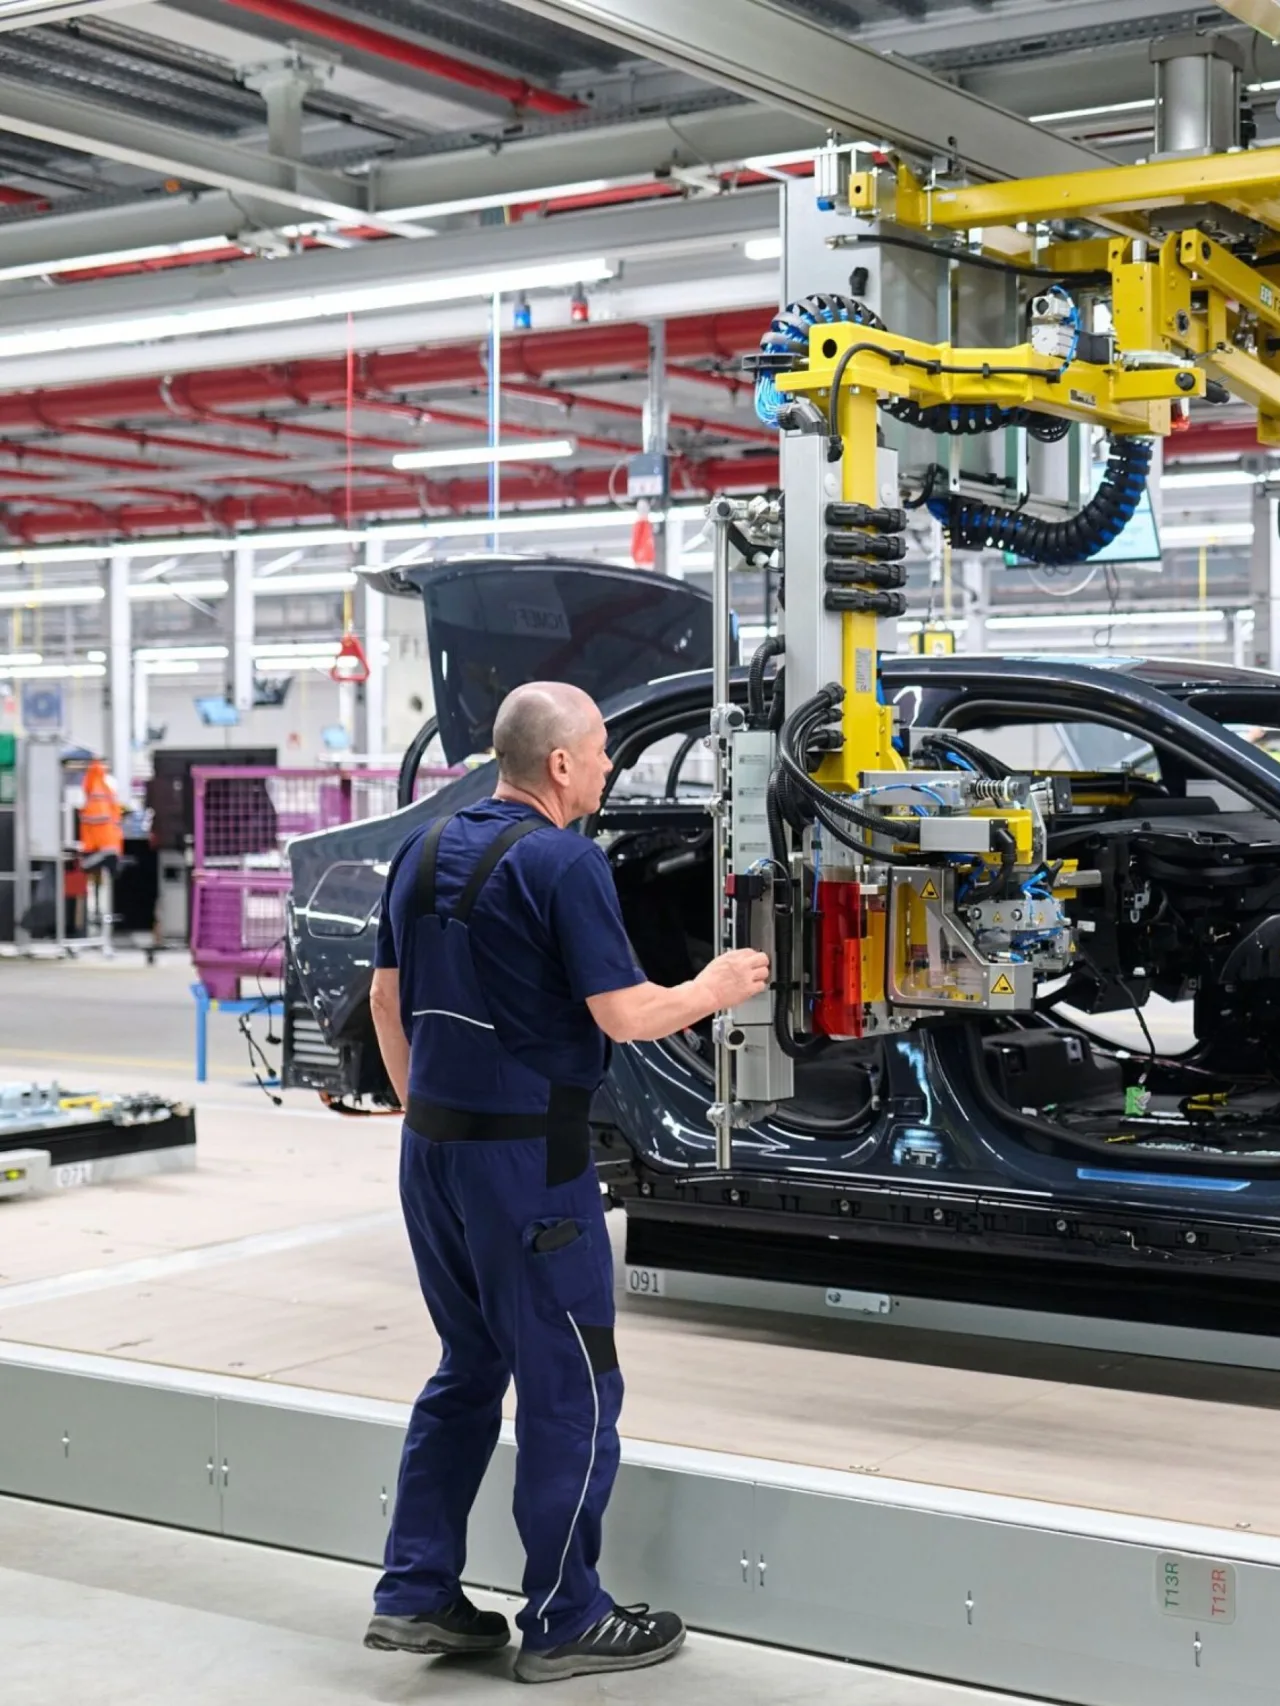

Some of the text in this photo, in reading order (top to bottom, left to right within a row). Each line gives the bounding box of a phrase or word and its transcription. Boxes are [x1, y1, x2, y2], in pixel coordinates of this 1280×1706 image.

[629, 1268, 660, 1293] 091
[1164, 1562, 1180, 1608] T13R
[1211, 1569, 1227, 1616] T12R
